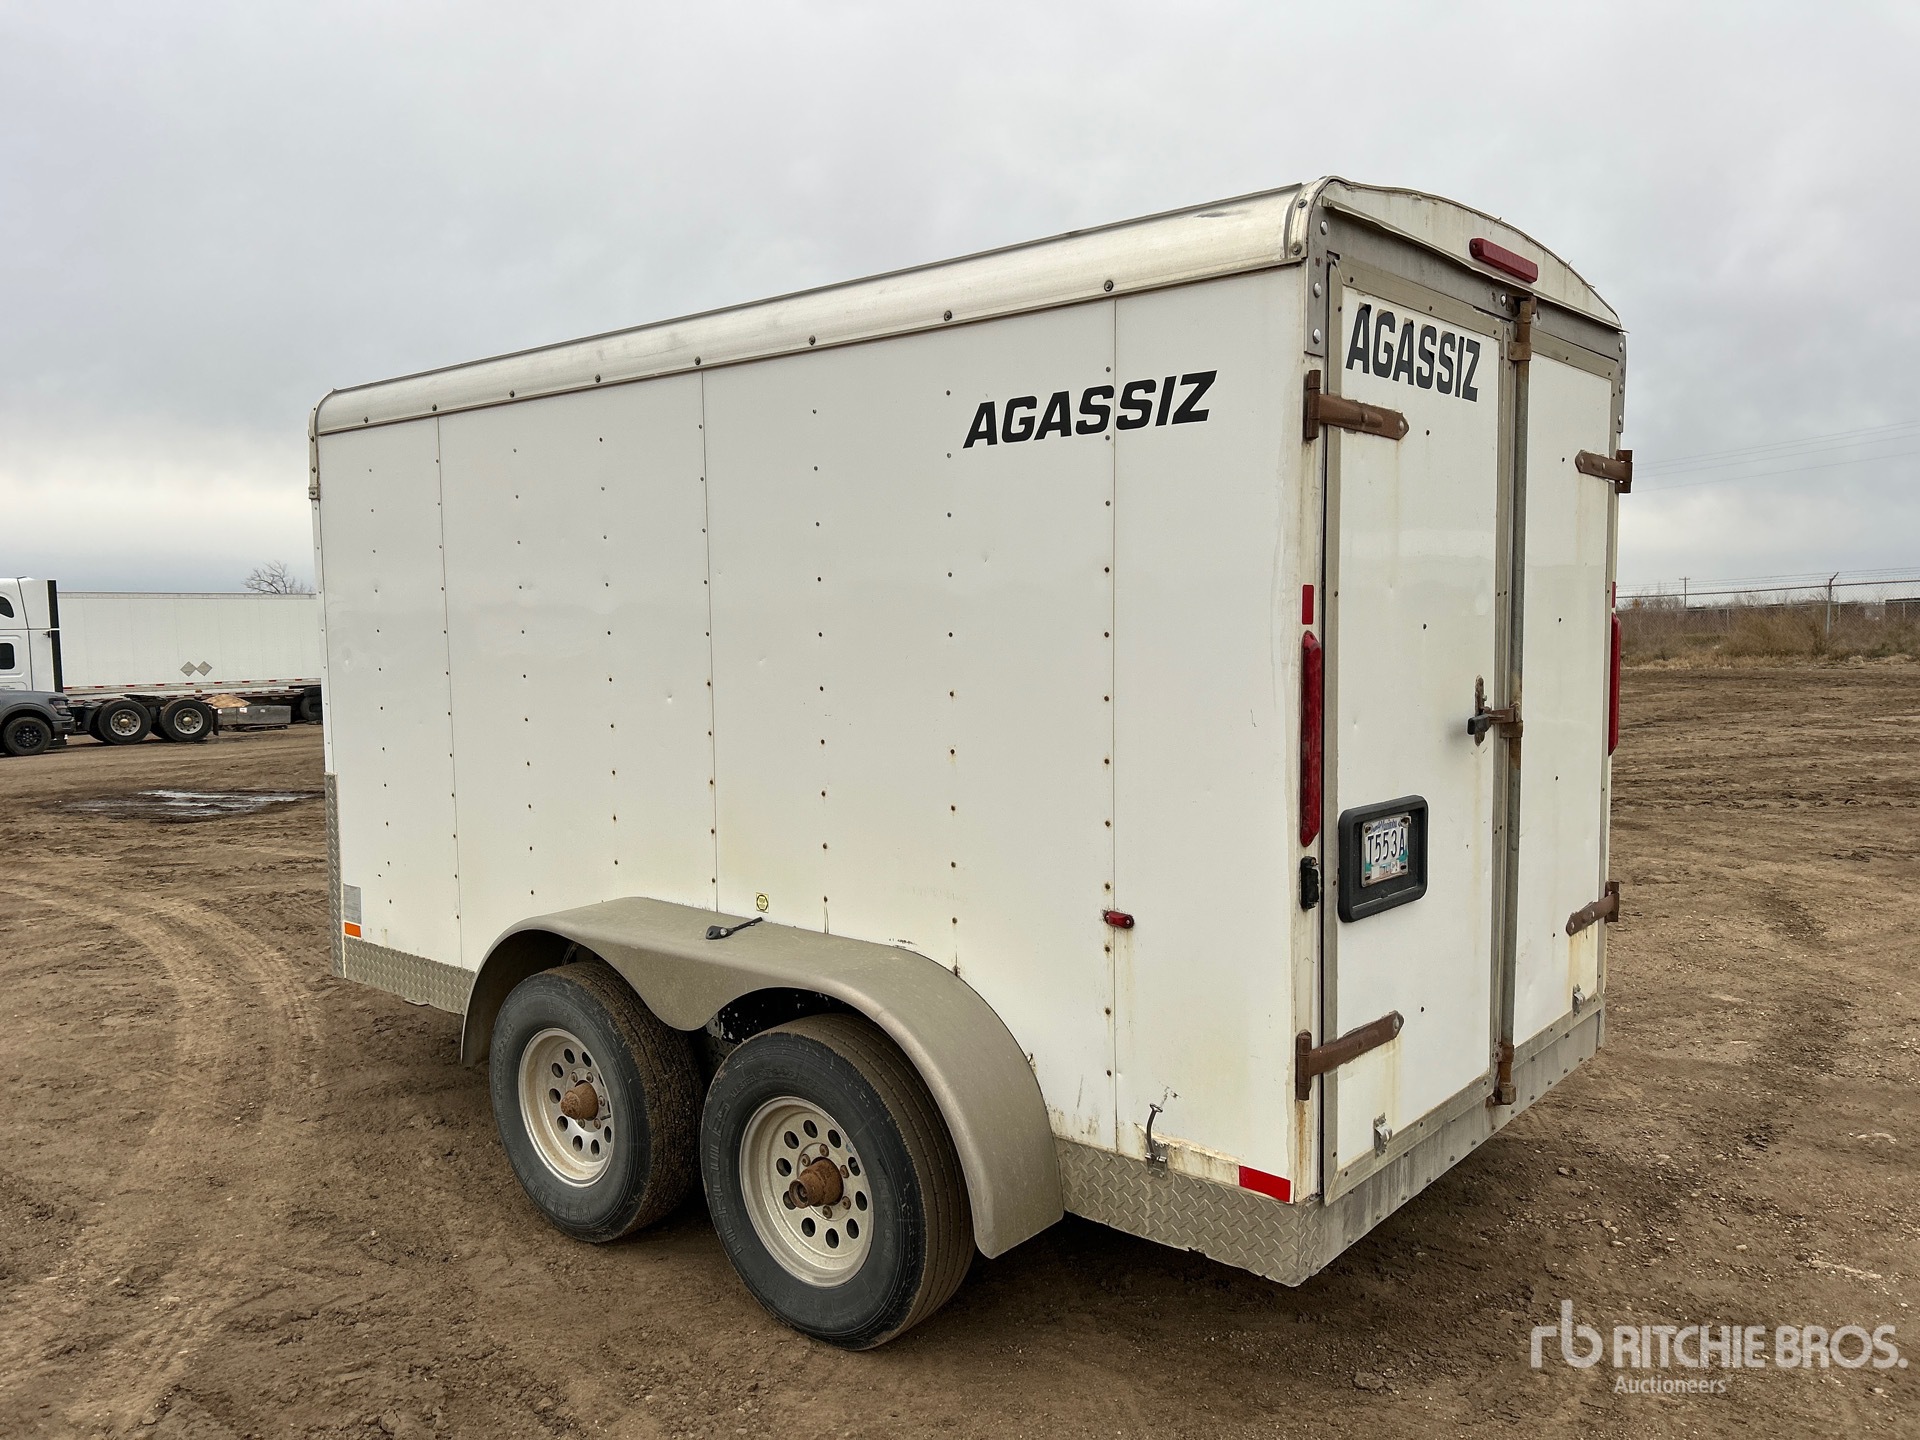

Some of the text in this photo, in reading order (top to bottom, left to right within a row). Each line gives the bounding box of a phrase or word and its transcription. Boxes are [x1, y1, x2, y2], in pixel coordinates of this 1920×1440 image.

[1345, 302, 1481, 402] AGASSIZ
[963, 370, 1217, 449] AGASSIZ
[1367, 827, 1405, 865] T553A
[708, 1101, 743, 1256] HERCULES
